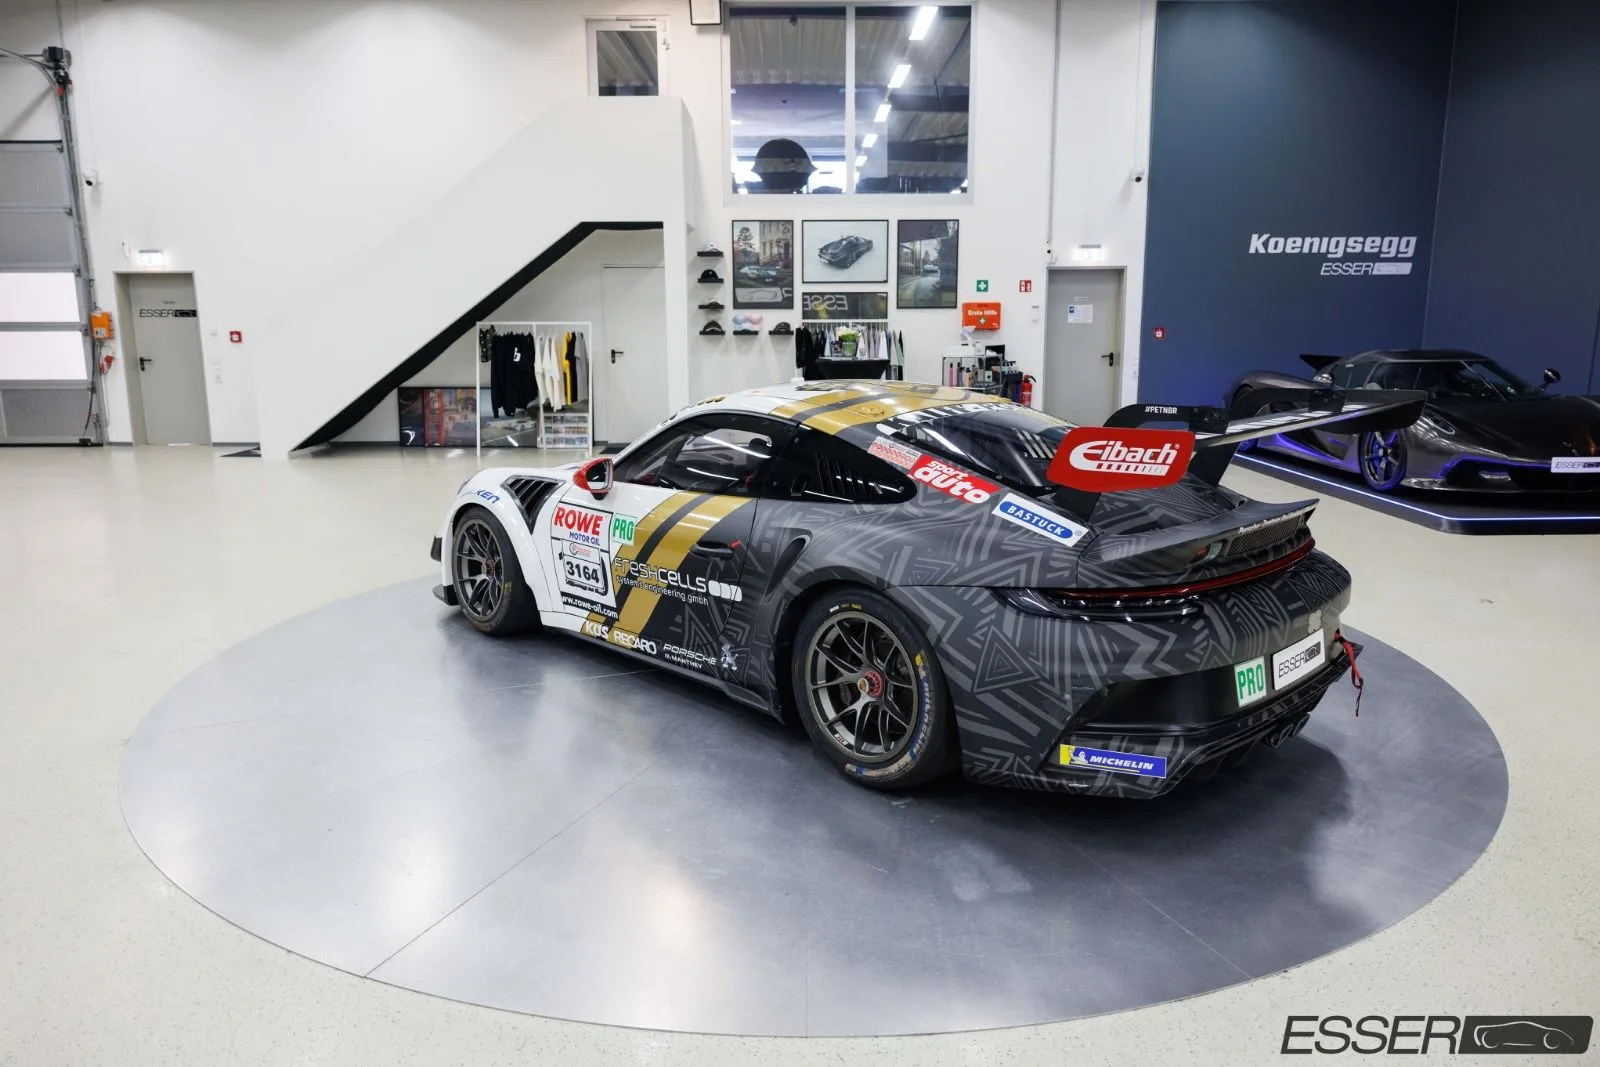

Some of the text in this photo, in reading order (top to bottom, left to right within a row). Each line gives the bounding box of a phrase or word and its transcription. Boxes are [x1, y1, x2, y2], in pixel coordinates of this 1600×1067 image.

[1249, 233, 1417, 258] Koenigsegg
[1320, 262, 1373, 275] ESSER
[139, 308, 174, 318] ESSER
[1144, 406, 1178, 414] #PETNBR
[1069, 440, 1177, 472] Eibach
[1555, 461, 1584, 469] ESSER
[927, 460, 969, 479] sport
[914, 466, 990, 503] auto
[554, 506, 603, 536] ROWE
[612, 518, 634, 541] PRO
[1007, 505, 1065, 536] BASTUCK
[569, 531, 600, 546] MOTOR OIL
[566, 560, 600, 583] 3164
[644, 582, 686, 602] engineering
[687, 594, 709, 606] gmbh
[613, 631, 657, 655] RECARO
[663, 643, 717, 666] PORSCHE
[1278, 651, 1305, 678] ESSER
[1237, 663, 1264, 700] PRO
[1089, 755, 1154, 770] MICHELIN
